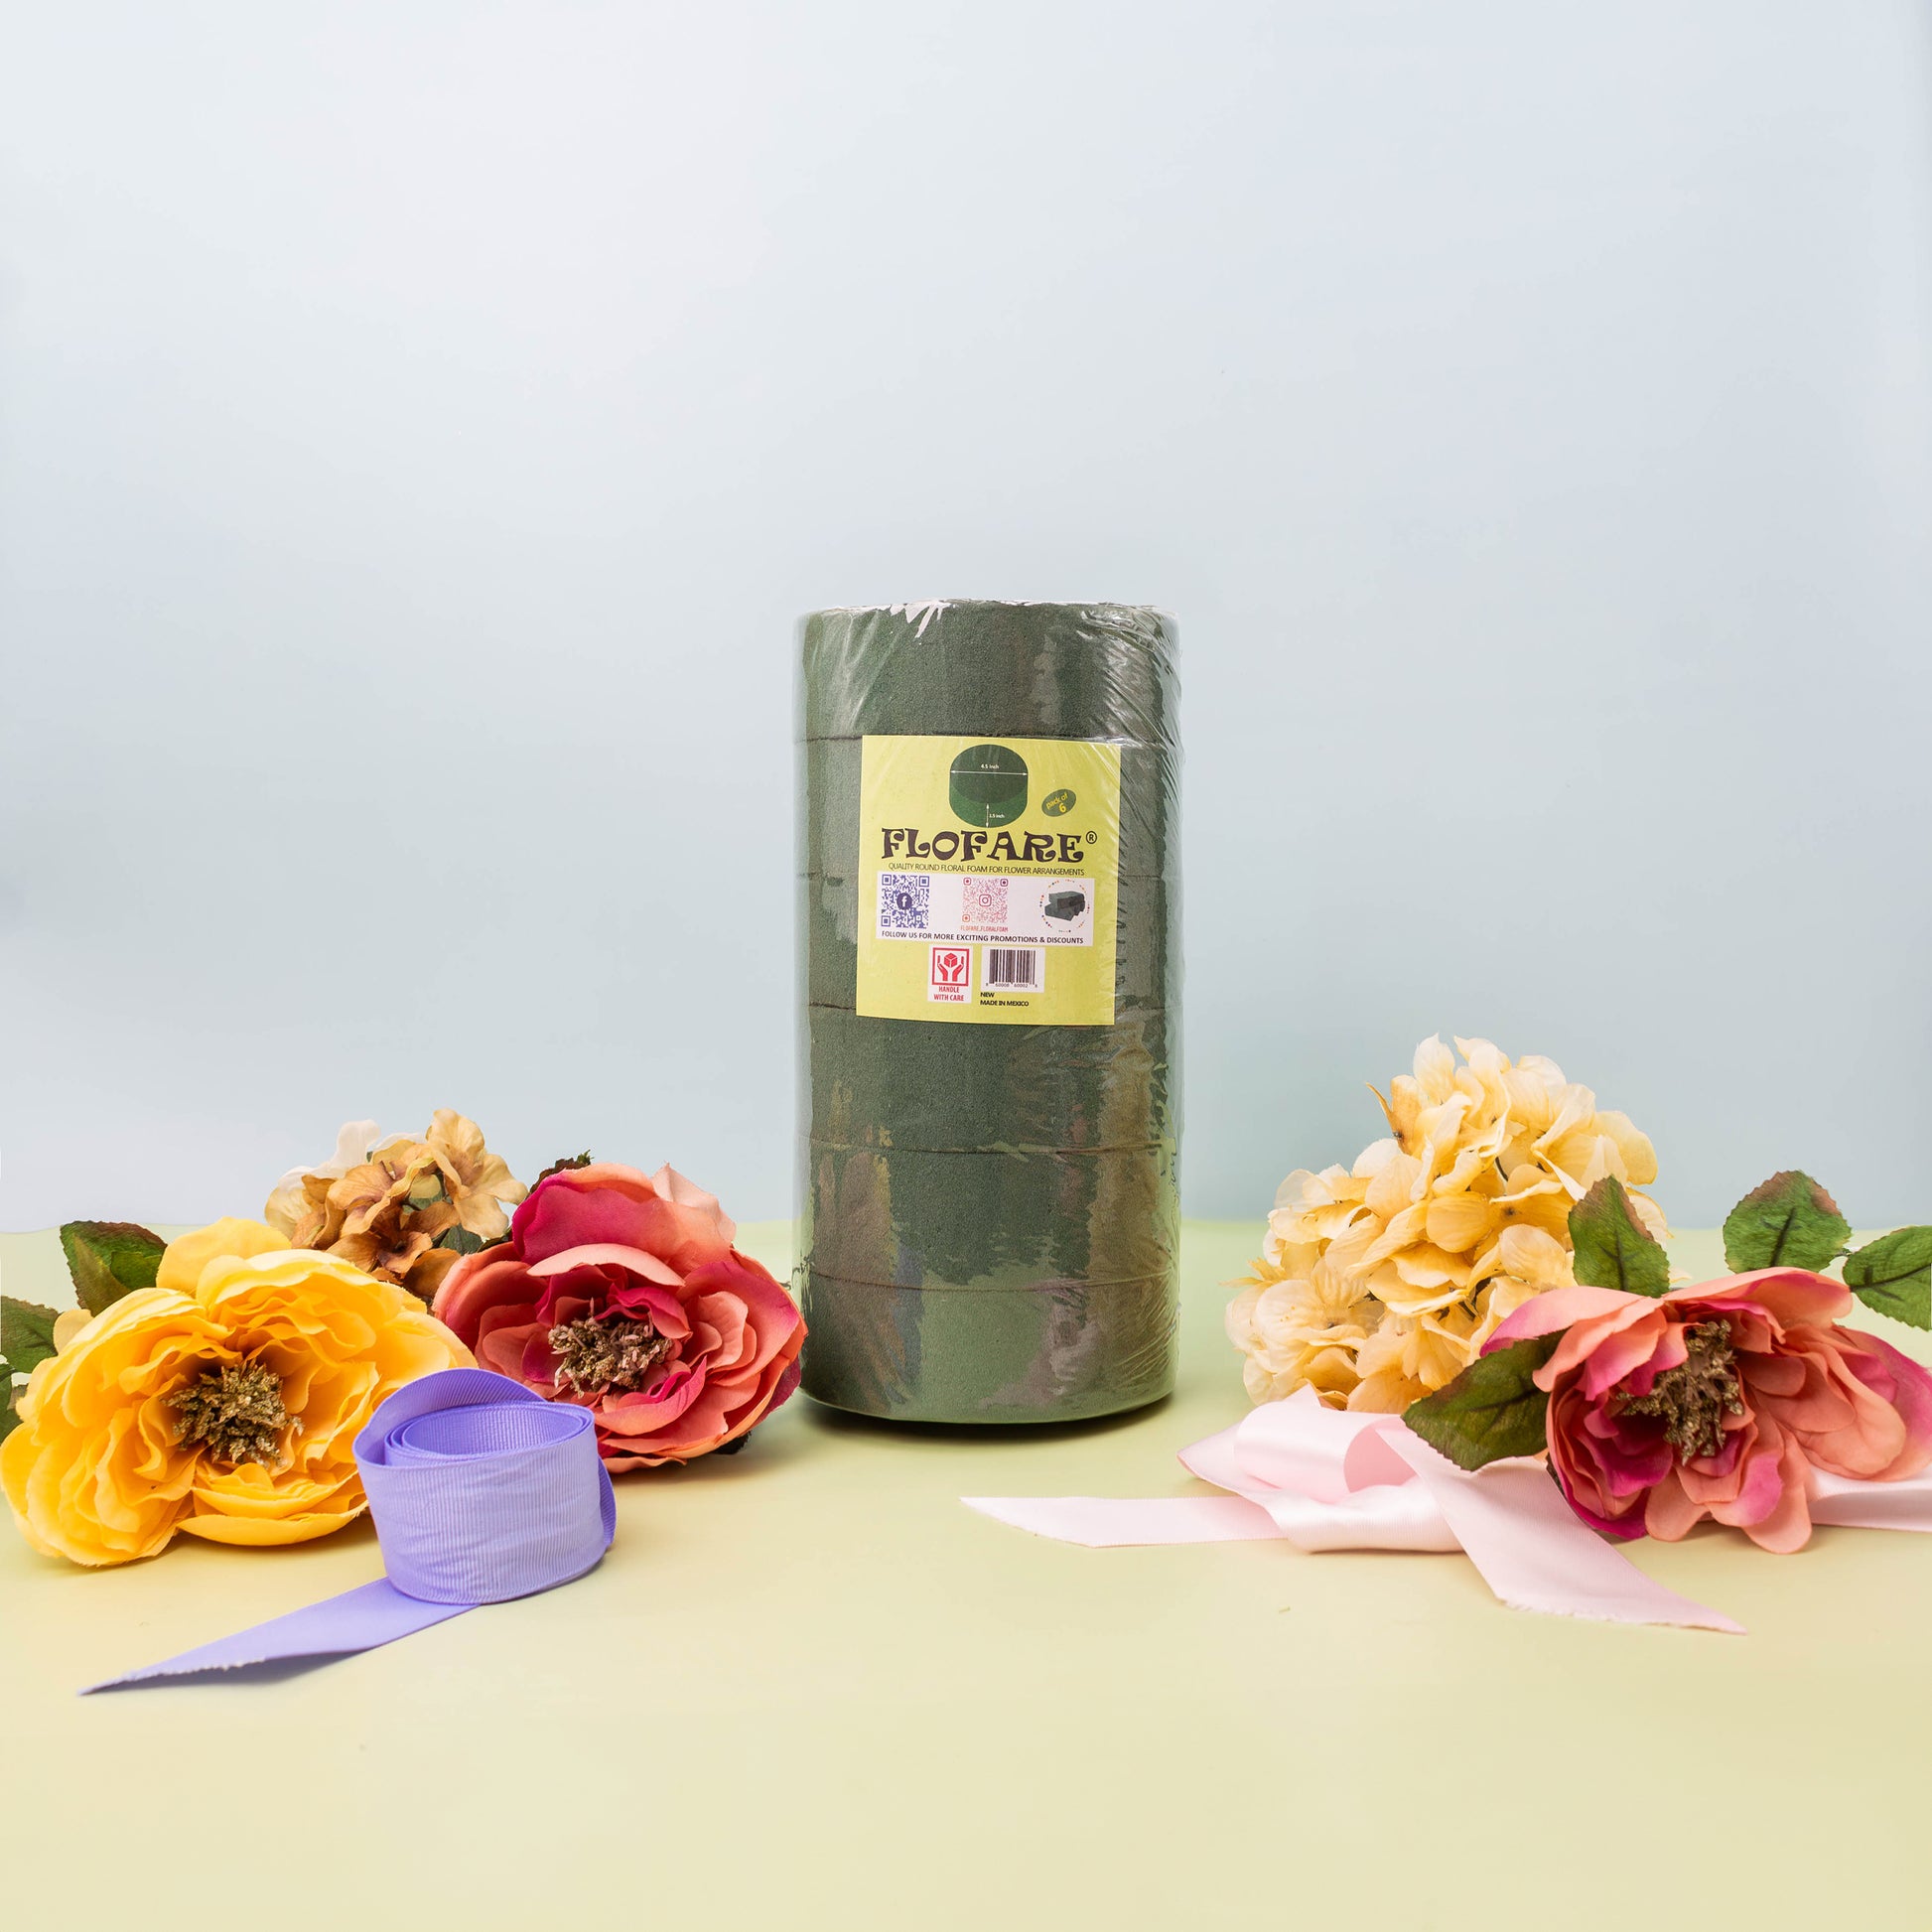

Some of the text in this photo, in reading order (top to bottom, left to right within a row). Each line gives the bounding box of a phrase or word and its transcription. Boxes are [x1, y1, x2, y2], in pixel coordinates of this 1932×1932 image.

[1046, 792, 1068, 810] pack of
[1058, 802, 1066, 813] 6
[882, 828, 1084, 863] FLOFARE
[914, 863, 939, 872] ROUND
